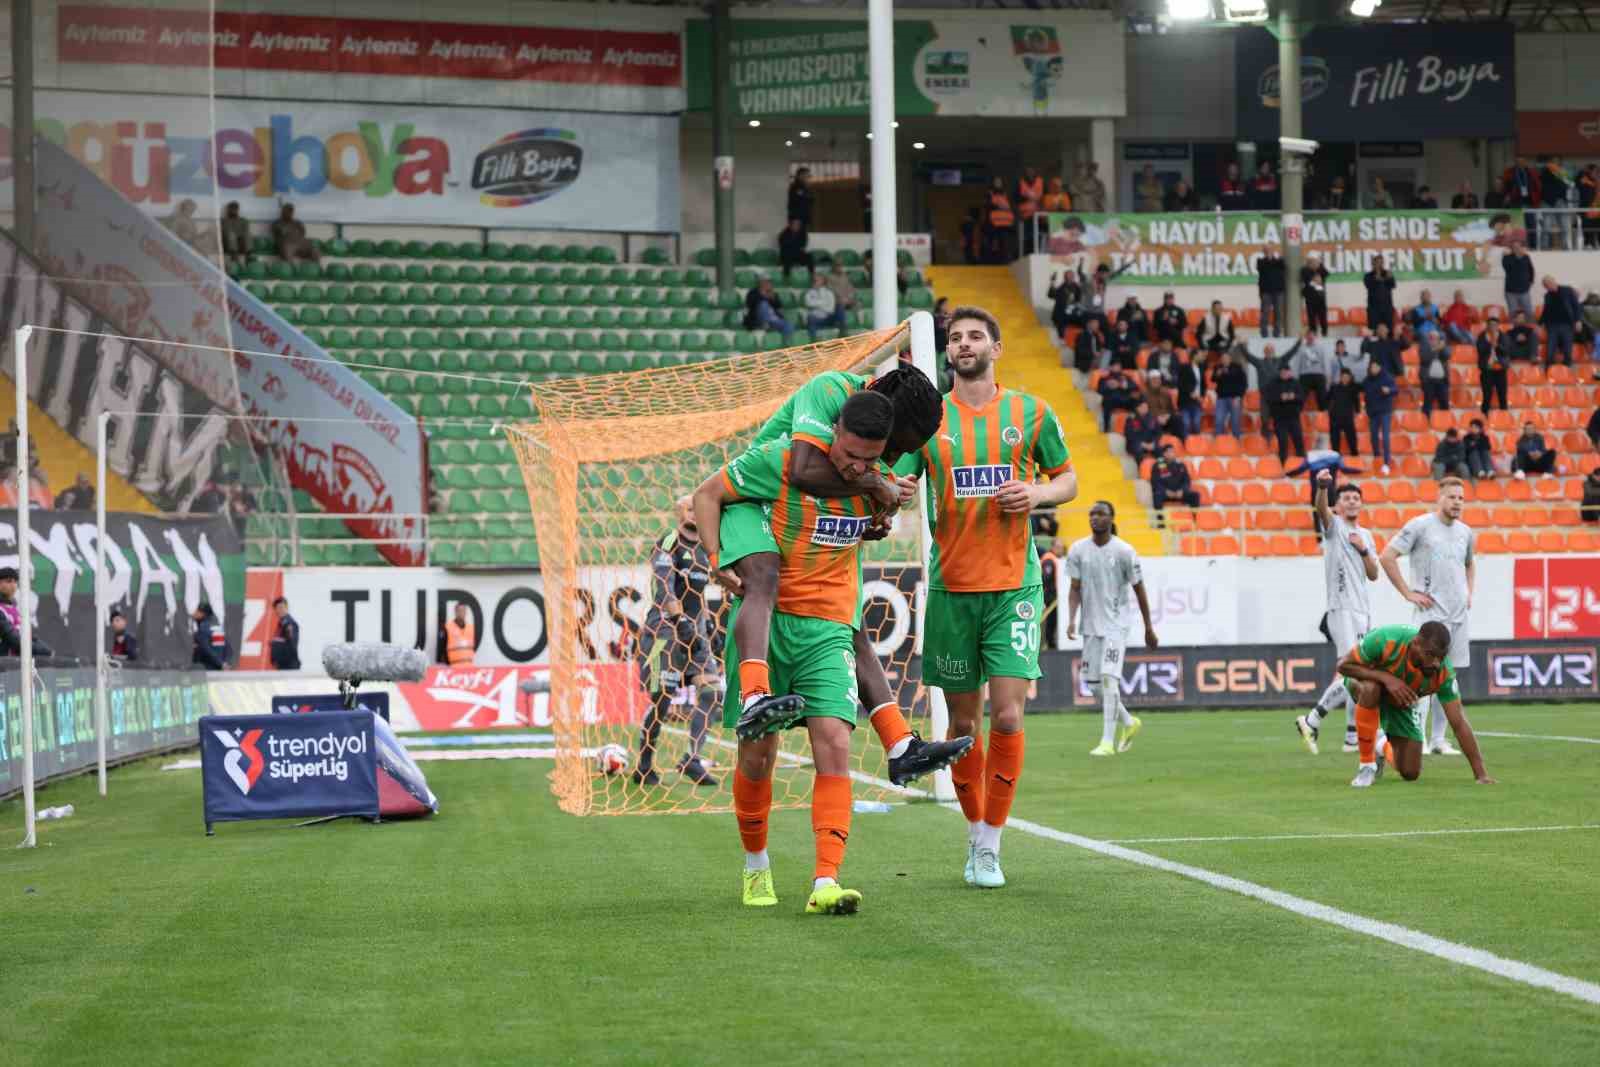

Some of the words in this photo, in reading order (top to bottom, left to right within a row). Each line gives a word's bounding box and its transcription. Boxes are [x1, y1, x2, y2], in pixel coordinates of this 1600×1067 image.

[65, 23, 147, 42] Aytemiz
[250, 31, 331, 52] Aytemiz
[340, 36, 418, 56] Aytemiz
[429, 40, 506, 60] Aytemiz
[516, 44, 592, 63] Aytemiz
[602, 48, 678, 67] Aytemiz
[1350, 59, 1411, 107] Filli
[1416, 55, 1501, 102] Boya
[479, 151, 519, 184] Filli
[522, 150, 577, 184] Boya
[1150, 216, 1225, 244] HAYDİ
[1232, 219, 1351, 245] ALAYAM
[1359, 217, 1441, 240] SENDE
[1421, 249, 1466, 271] TUT
[1011, 622, 1038, 651] 50
[434, 669, 496, 688] Keyfi
[1079, 662, 1178, 696] MR
[1494, 655, 1592, 686] GMR
[268, 731, 367, 759] trendyol
[269, 757, 349, 783] SüperLig
